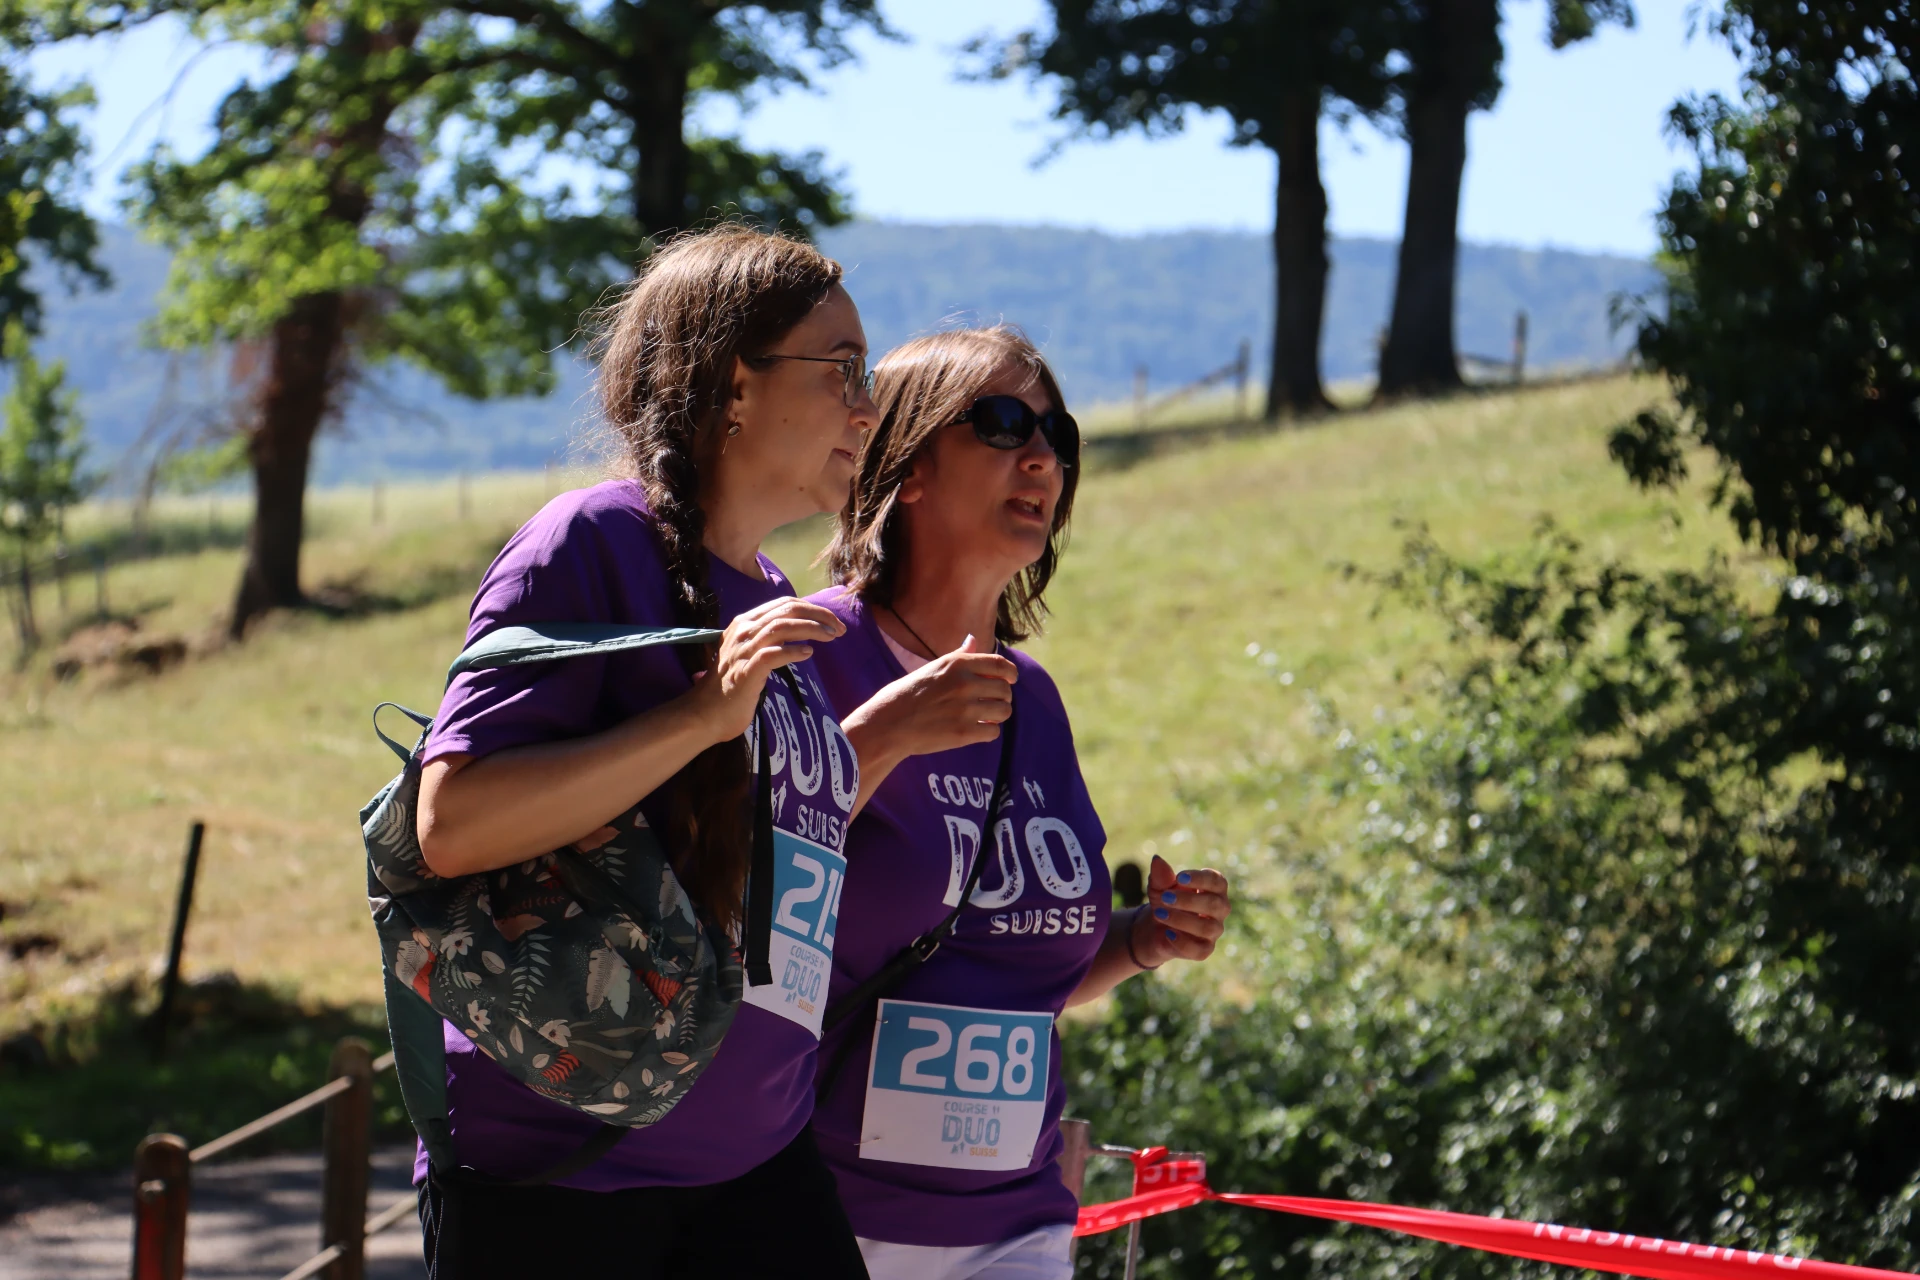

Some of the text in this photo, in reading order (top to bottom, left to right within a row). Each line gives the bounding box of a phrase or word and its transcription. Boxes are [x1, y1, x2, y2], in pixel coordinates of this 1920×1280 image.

[745, 692, 858, 812] DUO
[928, 773, 1014, 812] COURE
[942, 815, 1092, 909] DUO
[990, 905, 1096, 934] SUISSE
[790, 945, 819, 967] COURSE
[781, 959, 821, 1002] DUO
[900, 1016, 1035, 1095] 268
[944, 1101, 988, 1115] COURSE
[941, 1115, 1001, 1146] DUO
[970, 1147, 998, 1157] SUISSE
